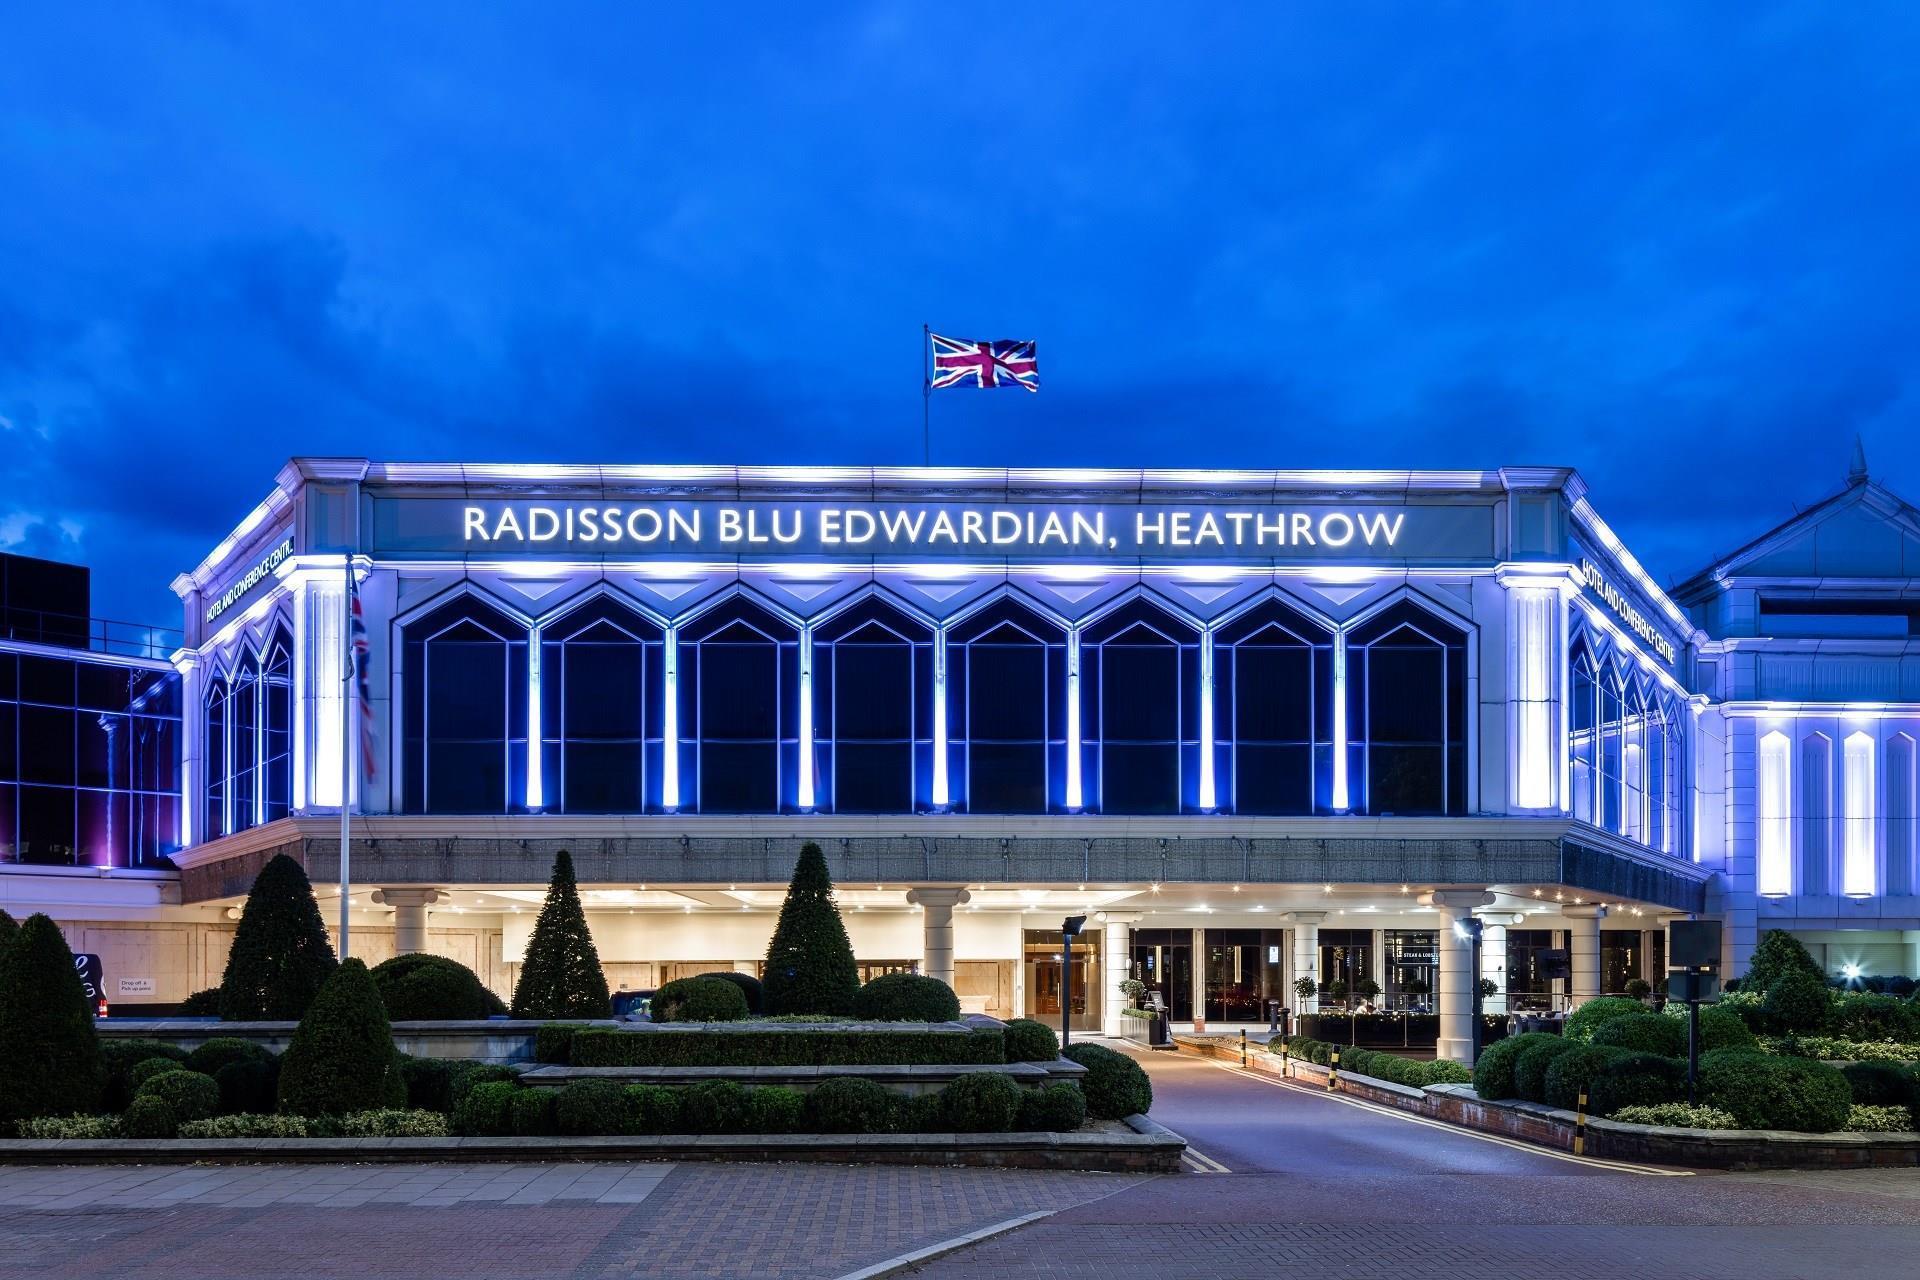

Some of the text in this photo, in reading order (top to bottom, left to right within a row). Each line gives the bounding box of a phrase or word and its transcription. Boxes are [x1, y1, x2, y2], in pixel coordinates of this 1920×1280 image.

[464, 507, 1404, 549] RADISSON BLU EDWARDIAN, HEATHROW
[206, 599, 224, 623] HOTEL
[221, 587, 235, 611] AND
[233, 557, 270, 600] CONFERENCE
[1582, 558, 1674, 665] HOTEL AND CONFERENCE CENTRE
